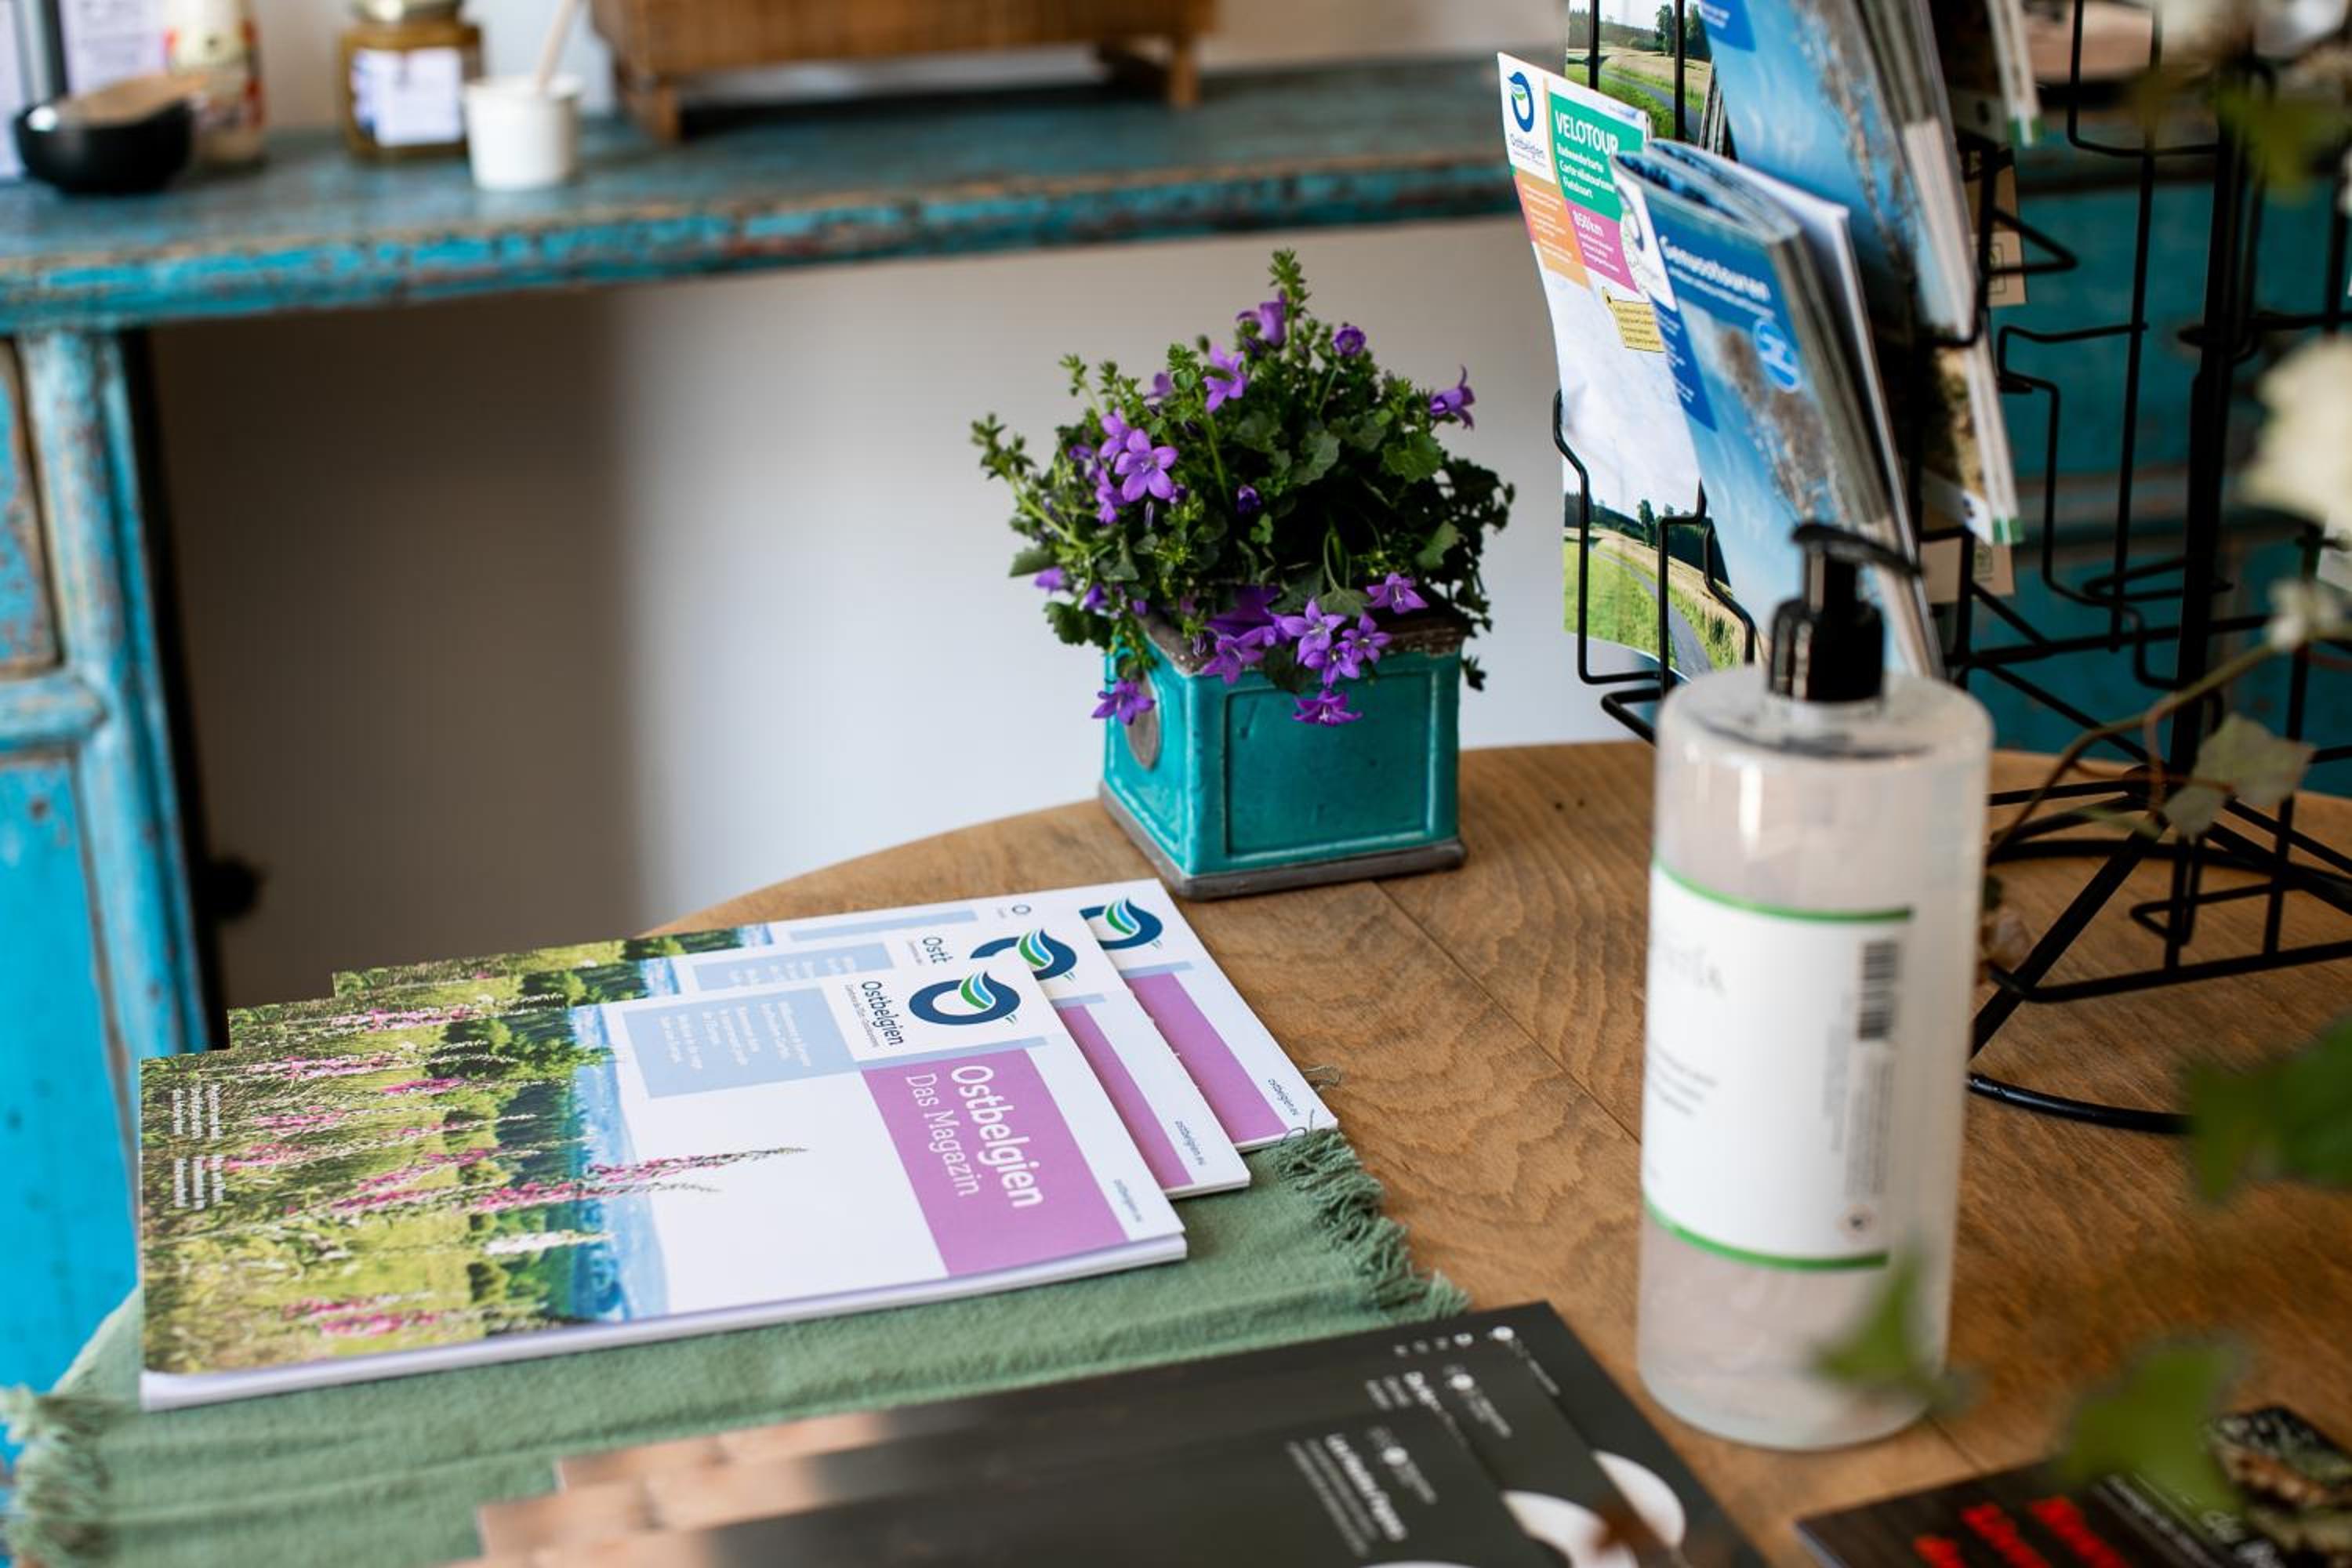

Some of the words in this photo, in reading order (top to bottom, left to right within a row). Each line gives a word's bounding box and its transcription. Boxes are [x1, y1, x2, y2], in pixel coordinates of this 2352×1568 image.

[1555, 110, 1619, 156] VELOTOUR
[862, 981, 904, 1046] Ostbelgien
[906, 1073, 939, 1107] Das
[923, 1109, 982, 1197] Magazin
[951, 1065, 1044, 1208] Ostbelgien
